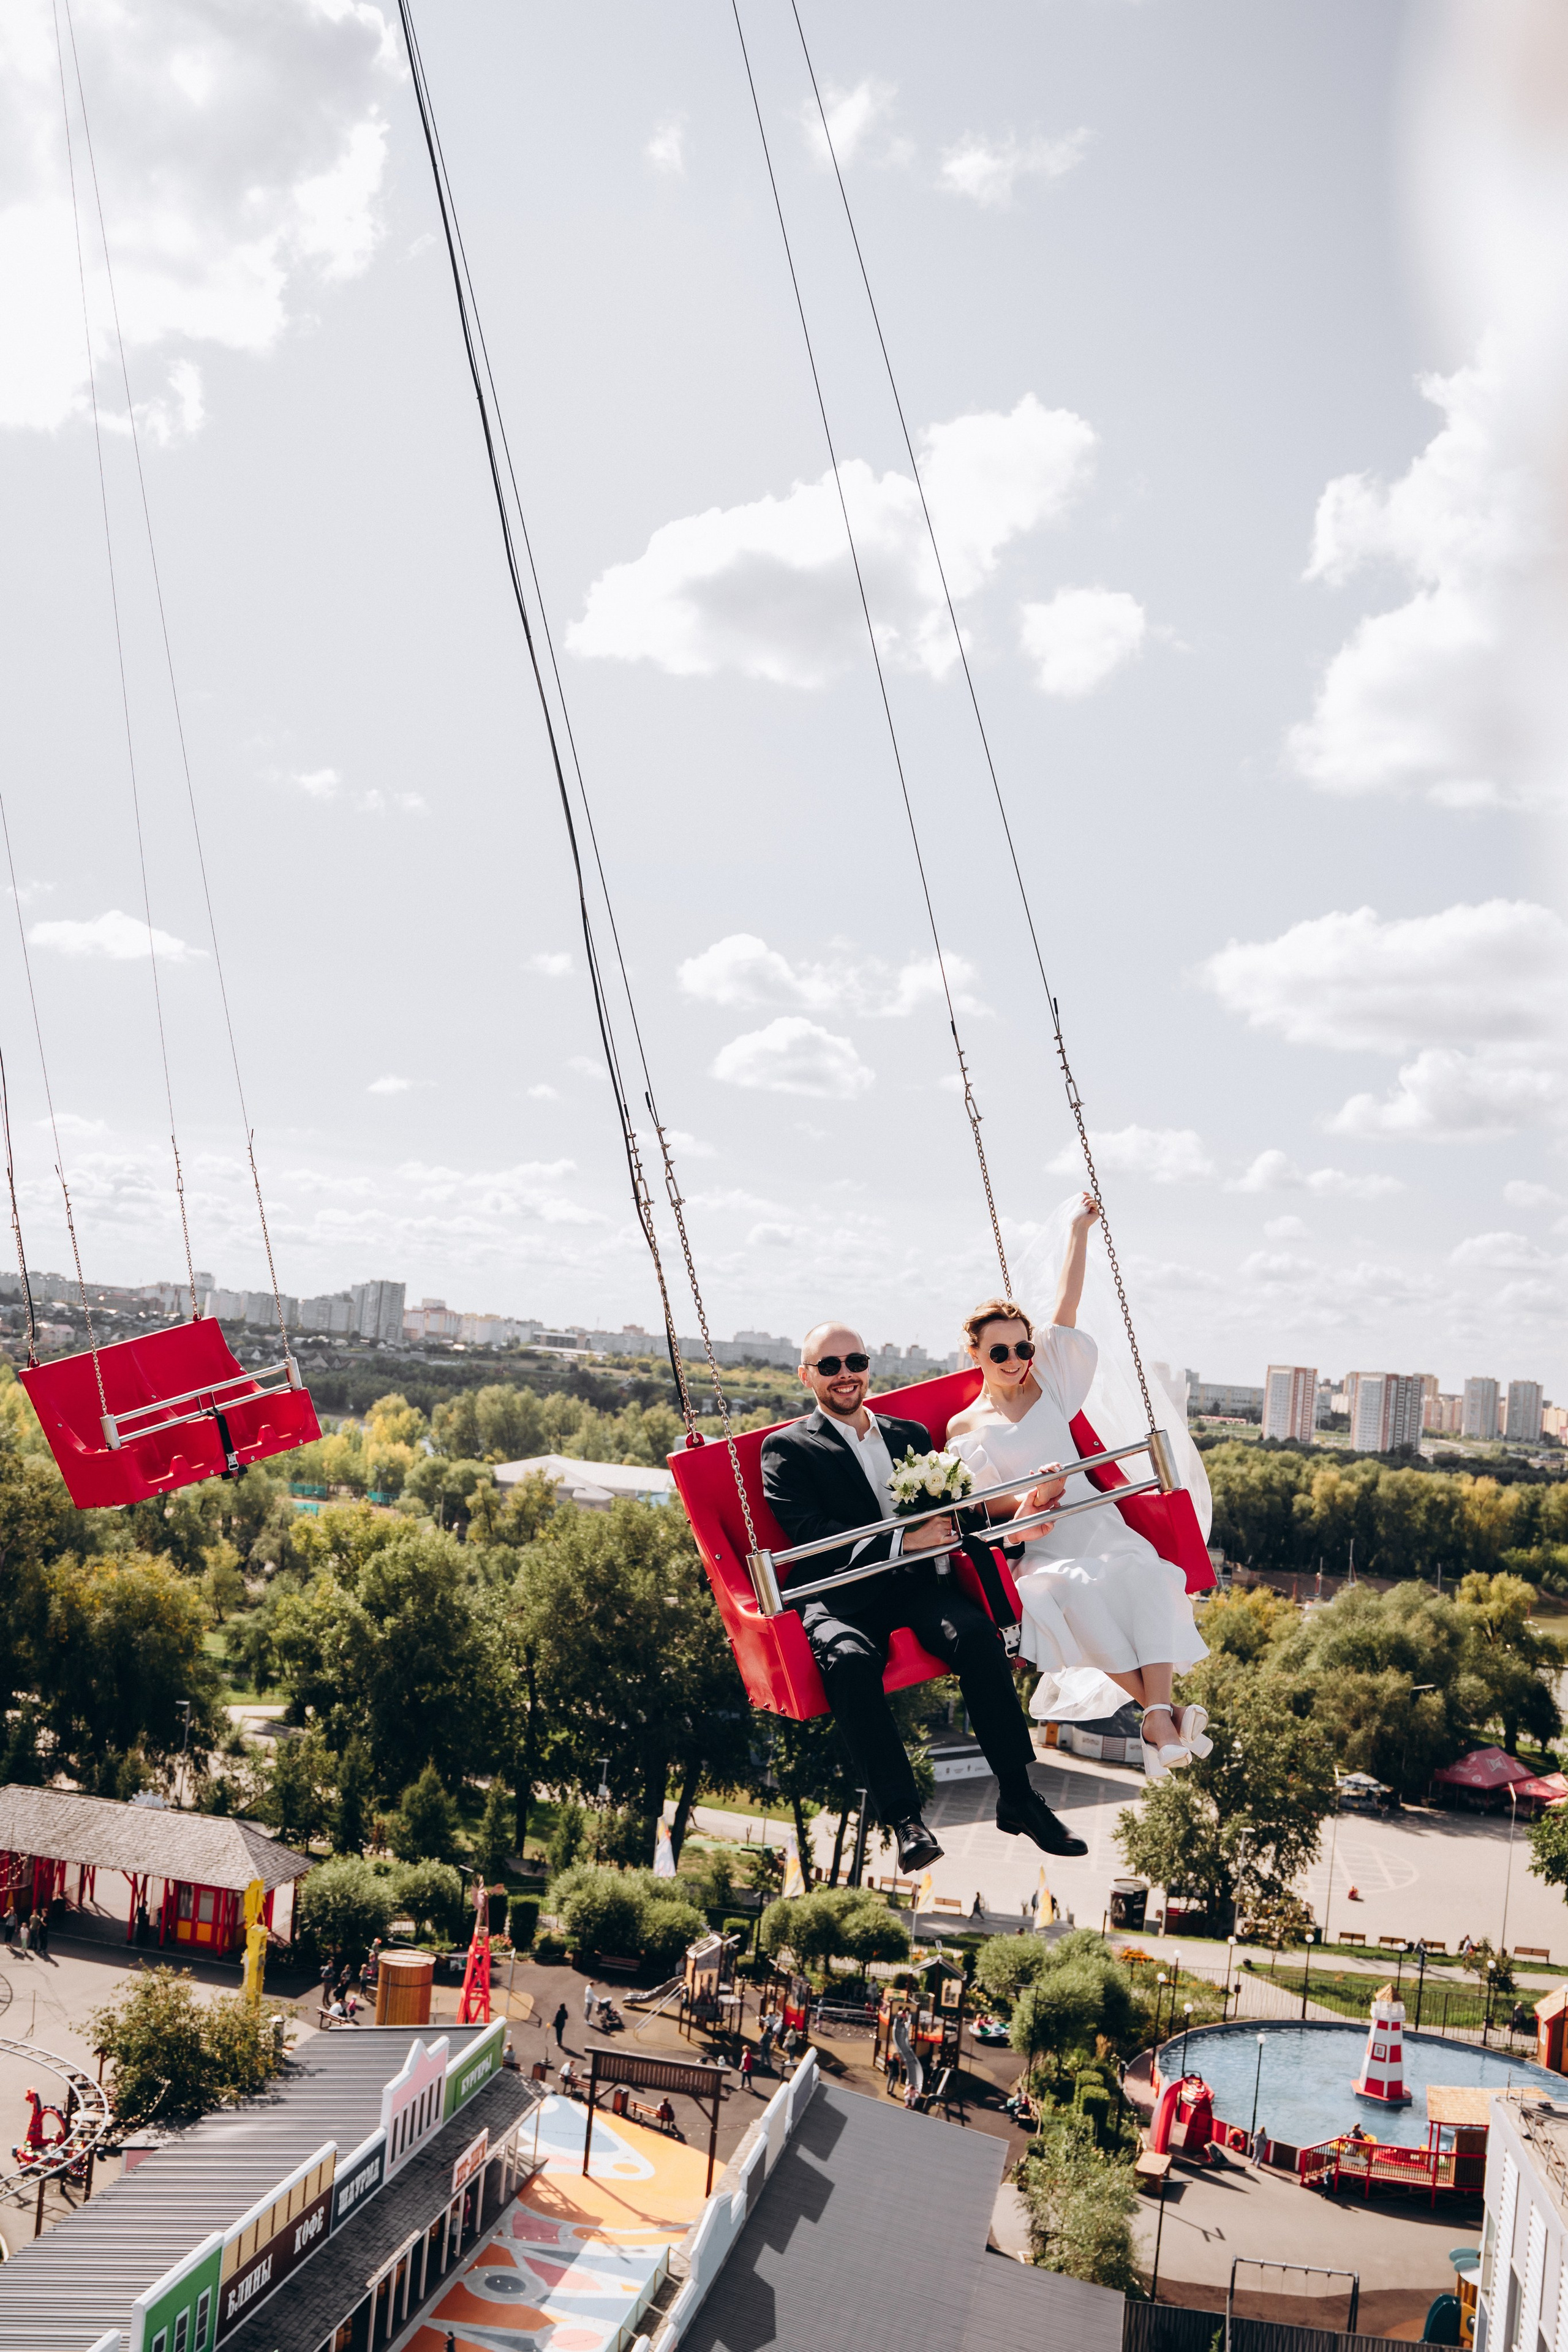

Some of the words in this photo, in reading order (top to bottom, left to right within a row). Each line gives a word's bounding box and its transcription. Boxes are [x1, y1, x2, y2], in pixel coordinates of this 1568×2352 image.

[337, 2156, 380, 2216] ШАУРМА
[226, 2253, 273, 2320] БЛИНЫ
[293, 2206, 325, 2255] КОФЕ
